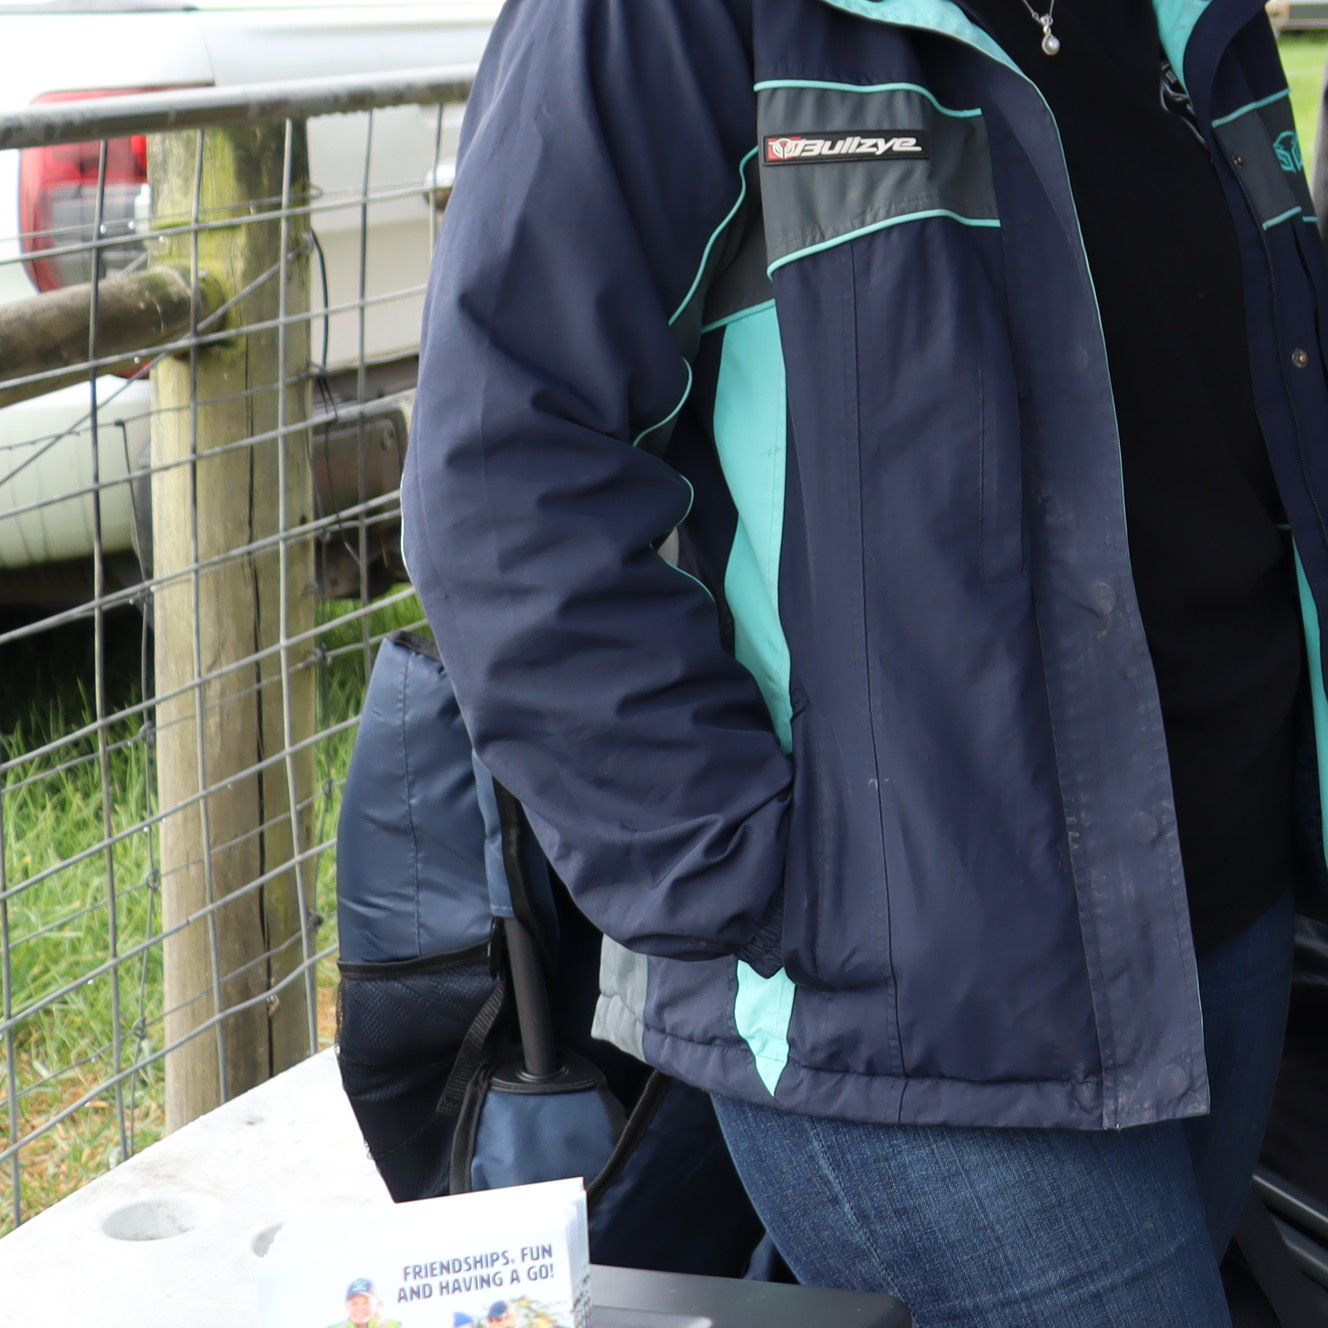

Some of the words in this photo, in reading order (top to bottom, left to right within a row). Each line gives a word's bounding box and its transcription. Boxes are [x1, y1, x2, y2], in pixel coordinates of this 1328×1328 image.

[796, 136, 923, 156] Bullzye
[402, 1250, 516, 1282] FRIENDSHIPS,
[521, 1244, 553, 1262] FUN
[397, 1283, 433, 1303] AND
[439, 1272, 504, 1296] HAVING
[510, 1269, 521, 1285] A
[527, 1263, 555, 1282] GO!
